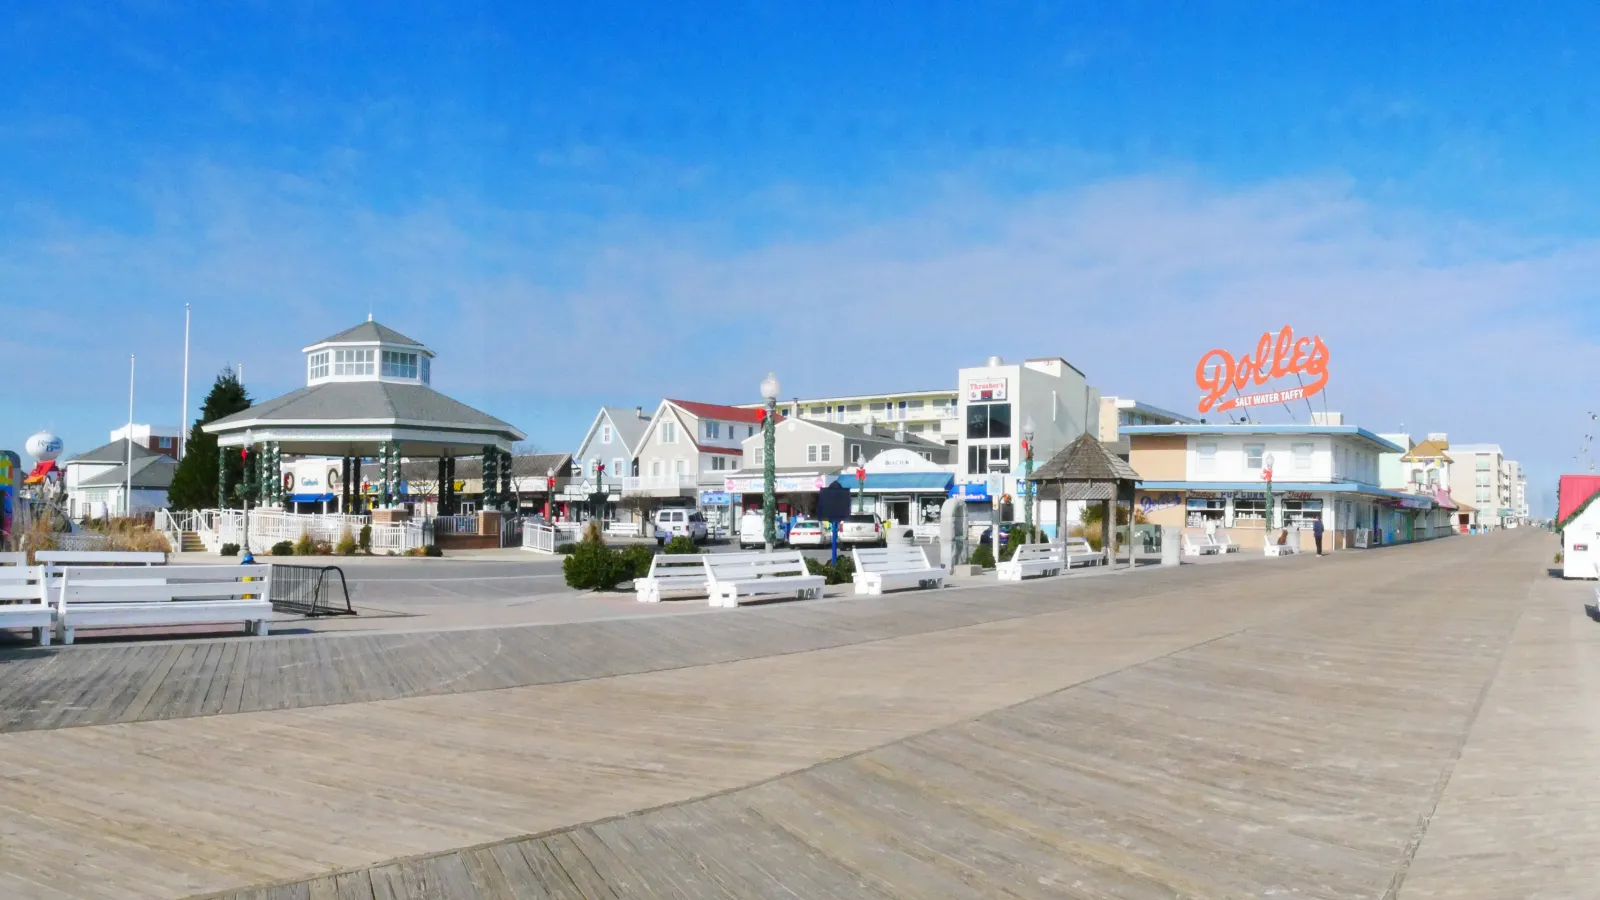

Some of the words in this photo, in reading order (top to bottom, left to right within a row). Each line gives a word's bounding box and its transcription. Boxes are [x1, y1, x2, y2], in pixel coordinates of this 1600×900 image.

[1235, 396, 1253, 407] SALT
[1253, 392, 1279, 405] WATER
[1280, 389, 1304, 401] TAFFY
